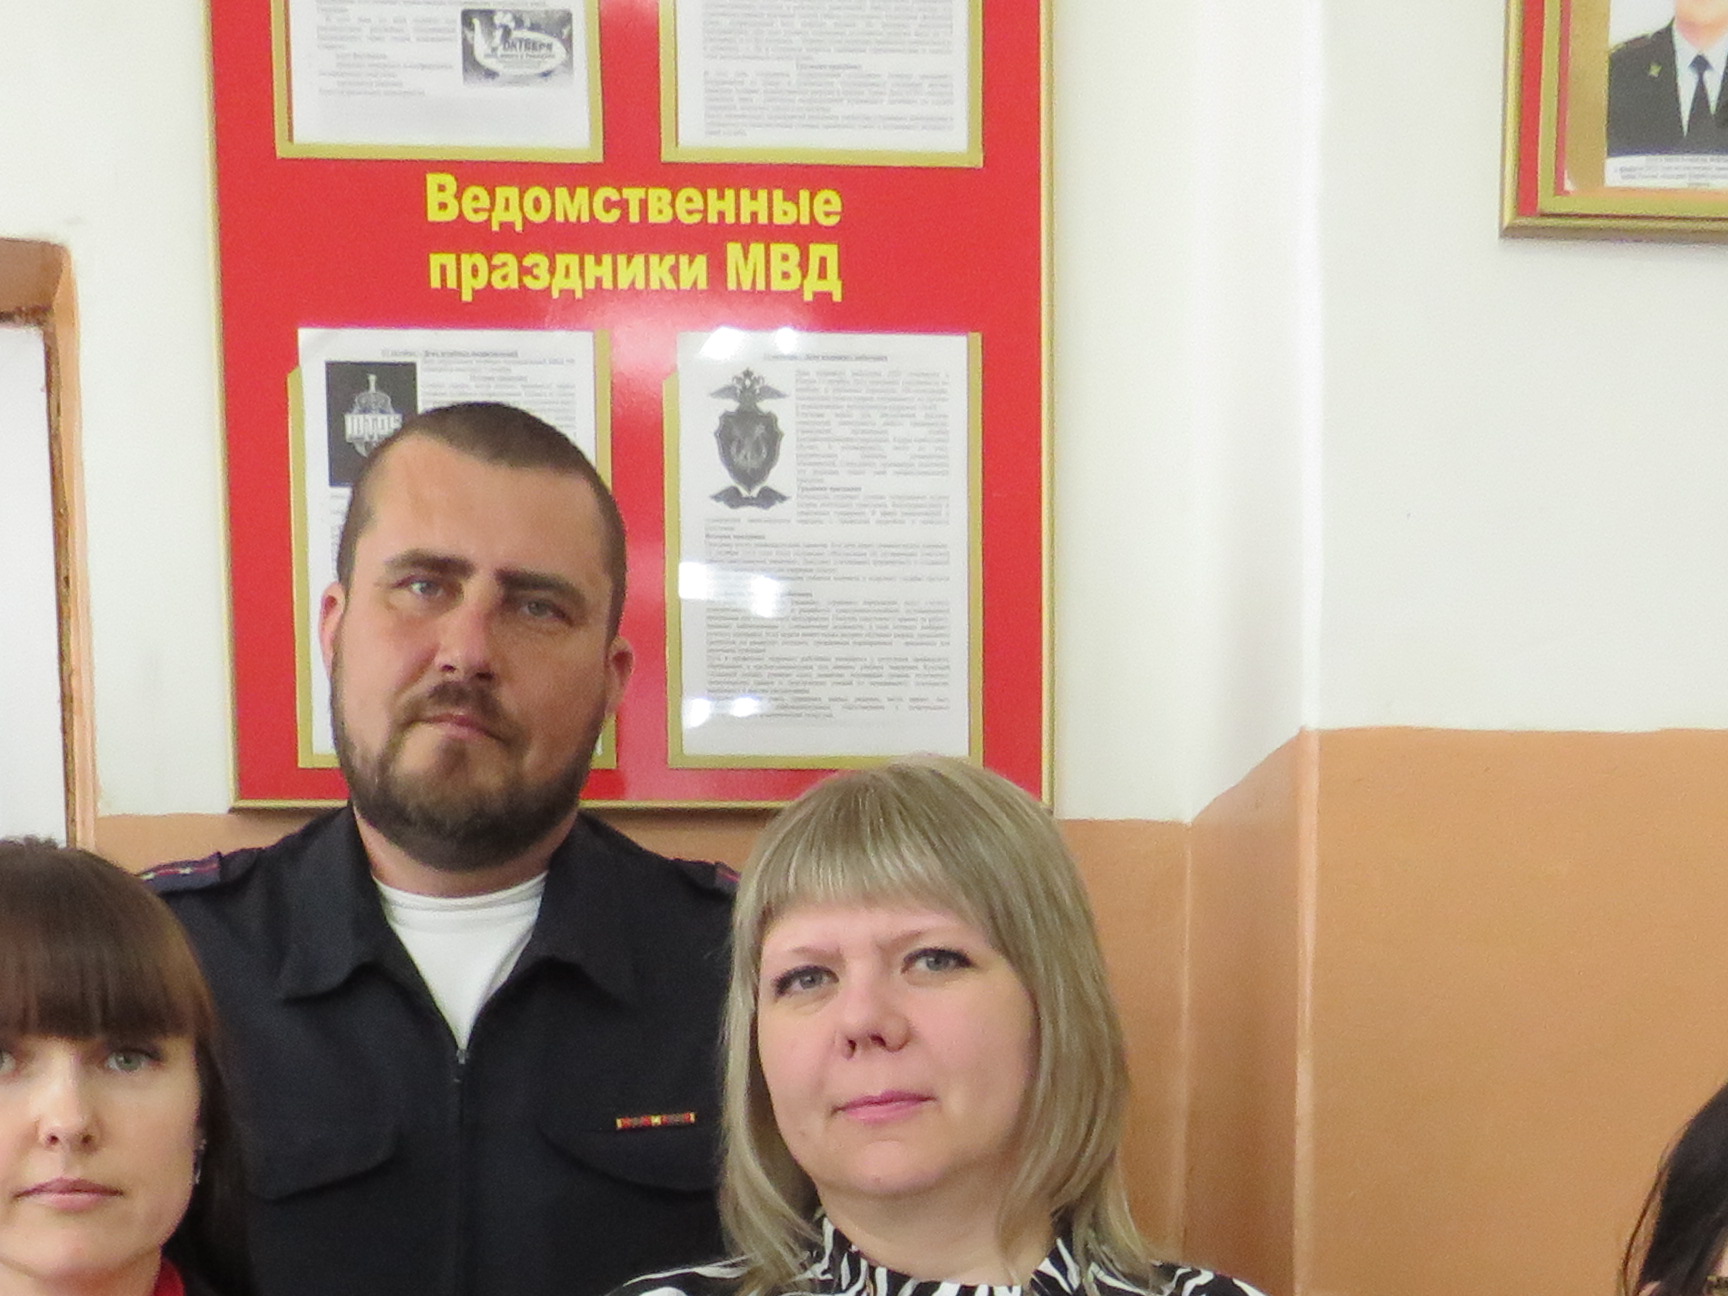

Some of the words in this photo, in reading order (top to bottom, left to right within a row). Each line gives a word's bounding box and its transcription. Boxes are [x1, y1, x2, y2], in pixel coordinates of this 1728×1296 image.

[426, 172, 843, 232] Ведомственные
[429, 252, 708, 302] праздники
[726, 242, 843, 302] МВД
